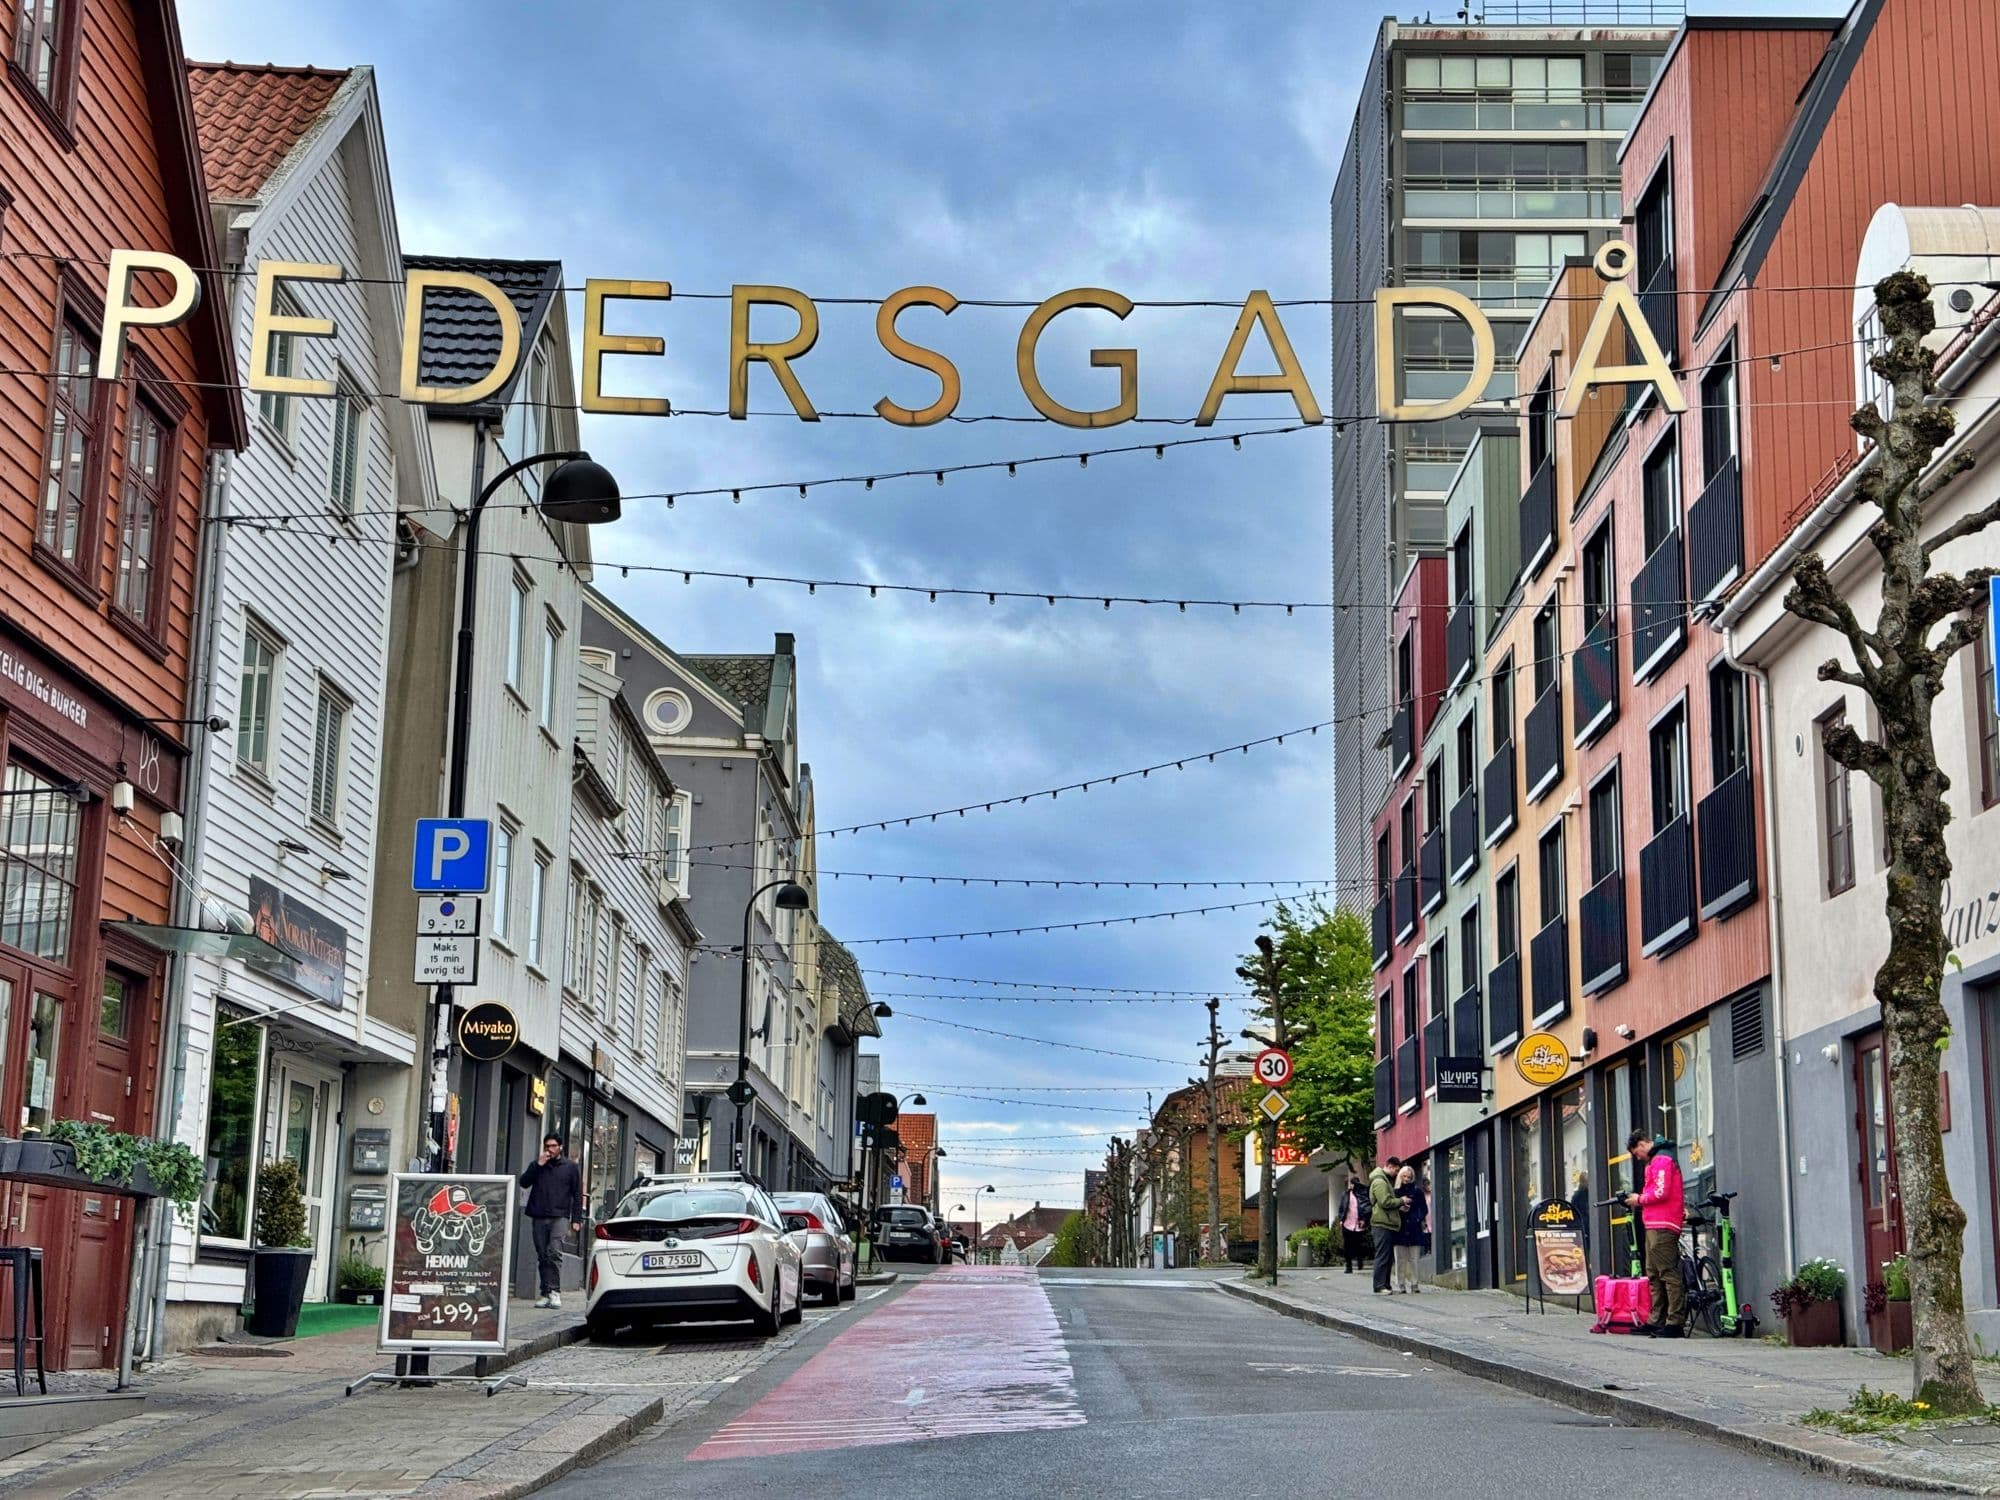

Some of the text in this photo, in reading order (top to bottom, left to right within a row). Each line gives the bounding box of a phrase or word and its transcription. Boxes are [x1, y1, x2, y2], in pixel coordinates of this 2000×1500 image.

[97, 240, 1688, 428] PEDERSGADÅ
[26, 669, 50, 703] DIGG
[50, 687, 87, 729] BURGER
[138, 730, 160, 794] P8
[431, 828, 470, 881] P
[427, 919, 435, 929] 9
[454, 919, 466, 930] 12
[433, 943, 458, 952] Maks
[430, 954, 460, 963] 15 min
[423, 966, 465, 977] øvrig tid
[464, 1020, 513, 1036] Miyako
[1262, 1058, 1286, 1077] 30
[1455, 1071, 1479, 1085] YIPS
[893, 1176, 901, 1186] P
[425, 1255, 469, 1269] HEKKAN
[651, 1254, 699, 1266] DR 75503
[432, 1302, 492, 1325] 199,-
